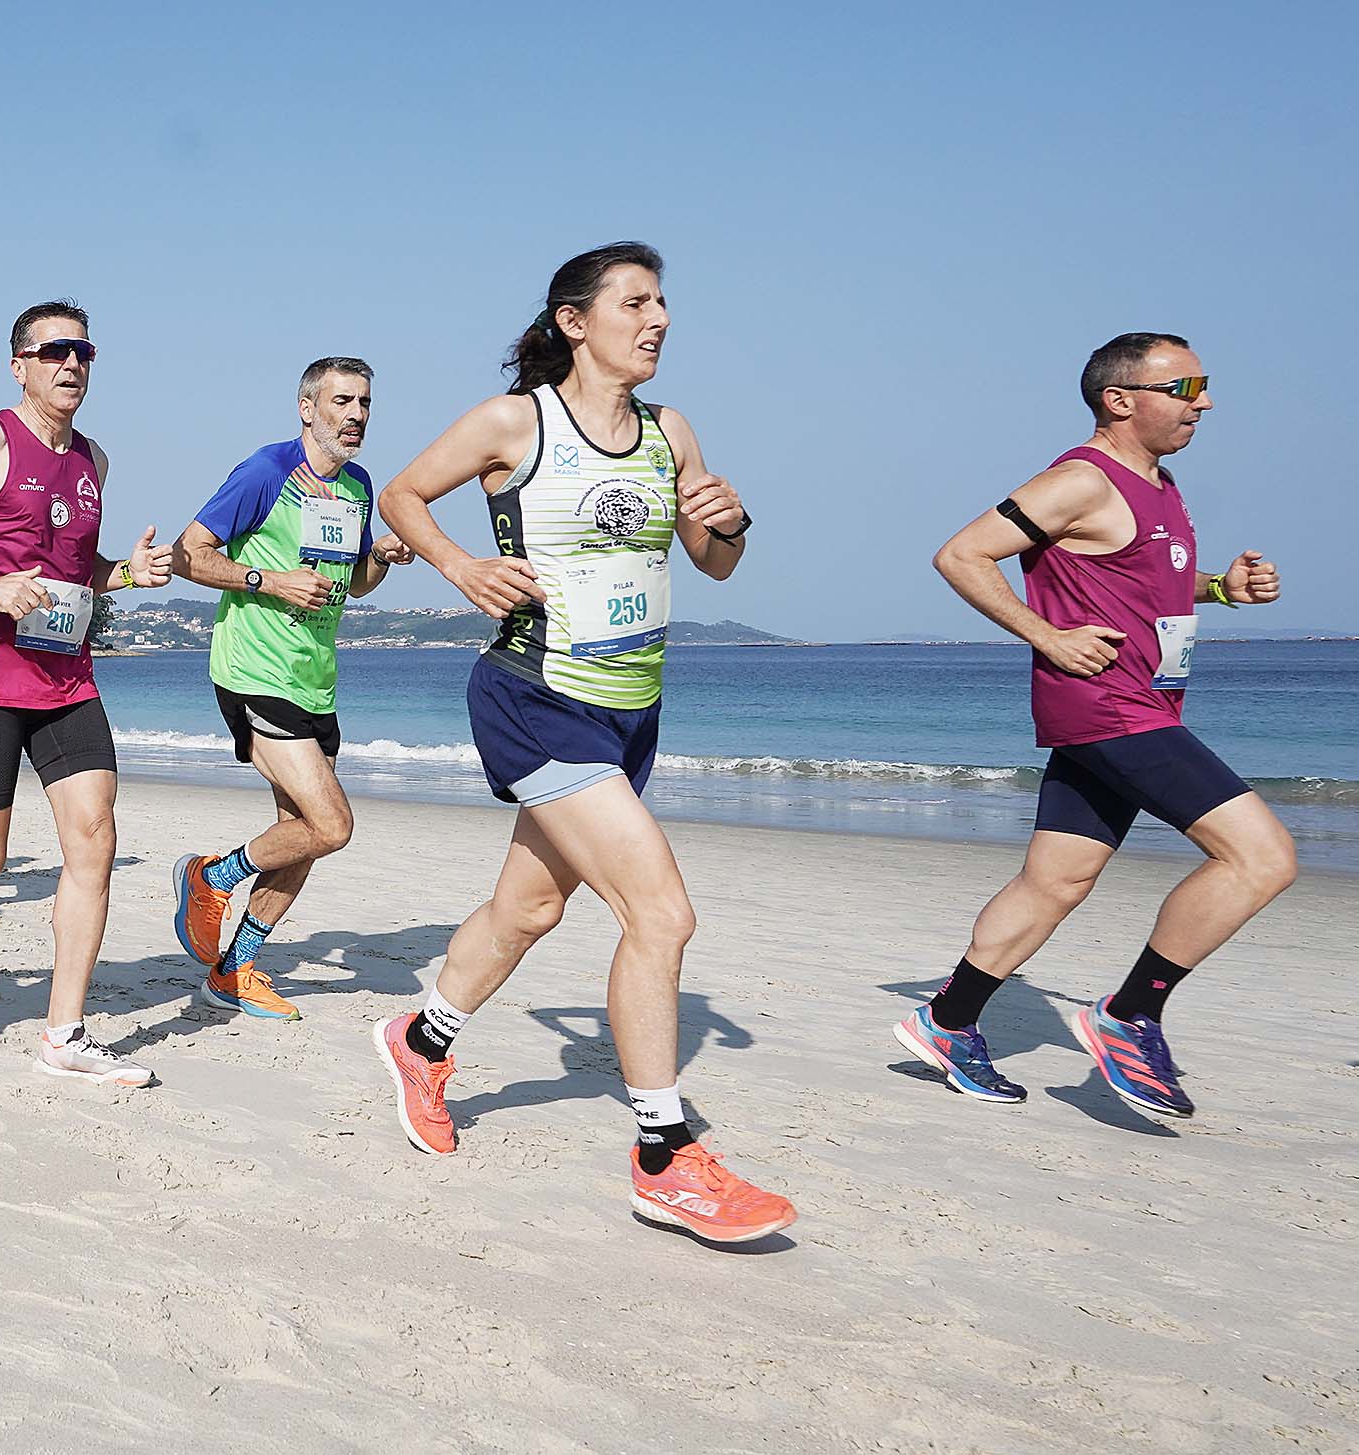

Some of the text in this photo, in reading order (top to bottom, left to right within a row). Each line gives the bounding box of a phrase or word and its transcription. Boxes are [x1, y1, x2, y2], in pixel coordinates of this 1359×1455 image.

[19, 483, 45, 492] amura
[321, 525, 343, 545] 135
[613, 581, 635, 590] PILAR
[53, 600, 72, 608] JAVIER
[607, 592, 647, 626] 259
[47, 610, 75, 634] 218
